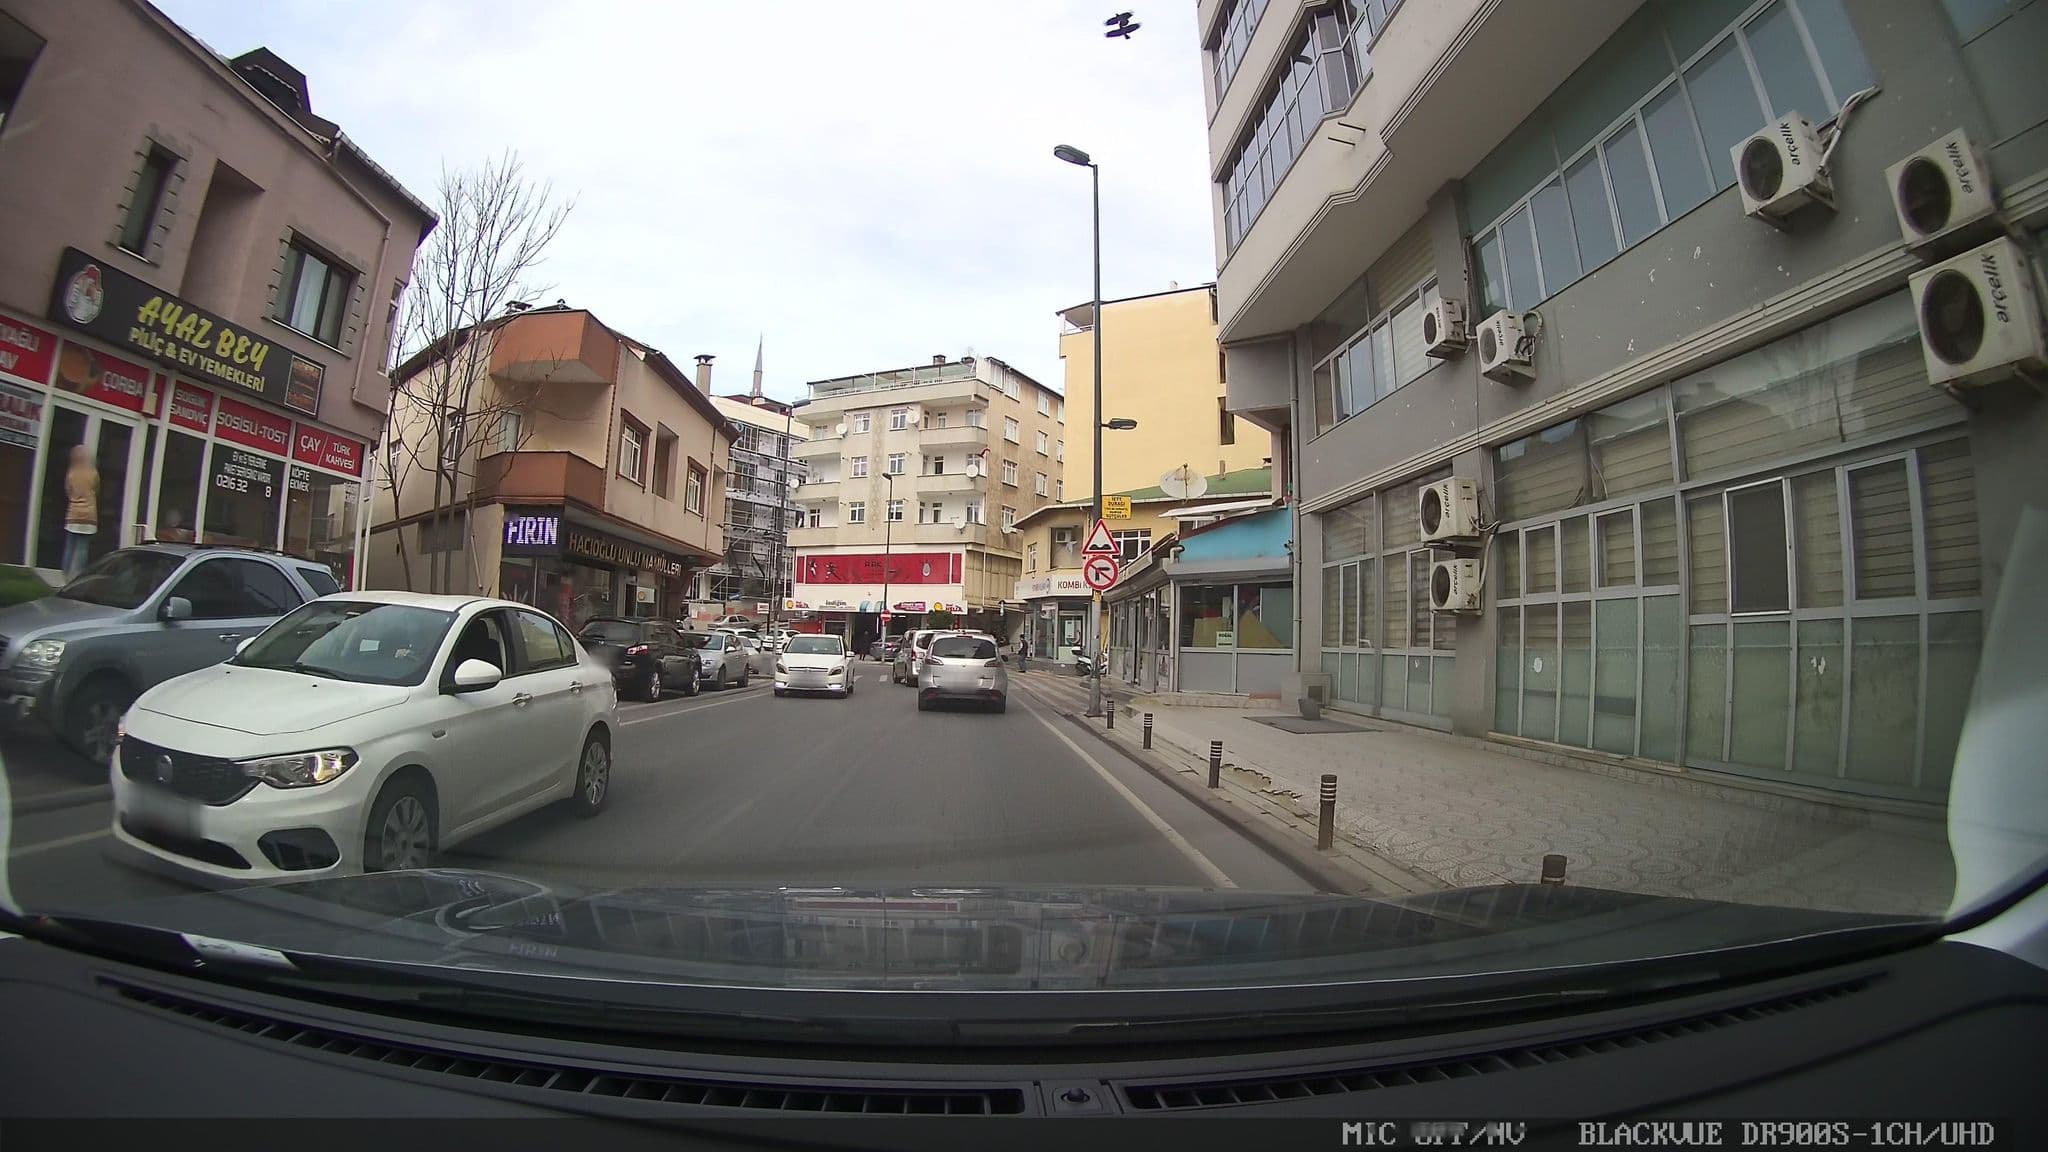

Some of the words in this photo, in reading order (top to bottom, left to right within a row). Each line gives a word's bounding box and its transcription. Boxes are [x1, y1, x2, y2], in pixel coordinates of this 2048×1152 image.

[139, 296, 213, 349] AYAZ
[215, 328, 269, 372] BEY
[102, 369, 145, 398] ÇORBA
[164, 341, 177, 360] &
[178, 347, 198, 367] EV
[199, 355, 266, 393] YEMEKLERİ
[300, 435, 321, 453] ÇAY
